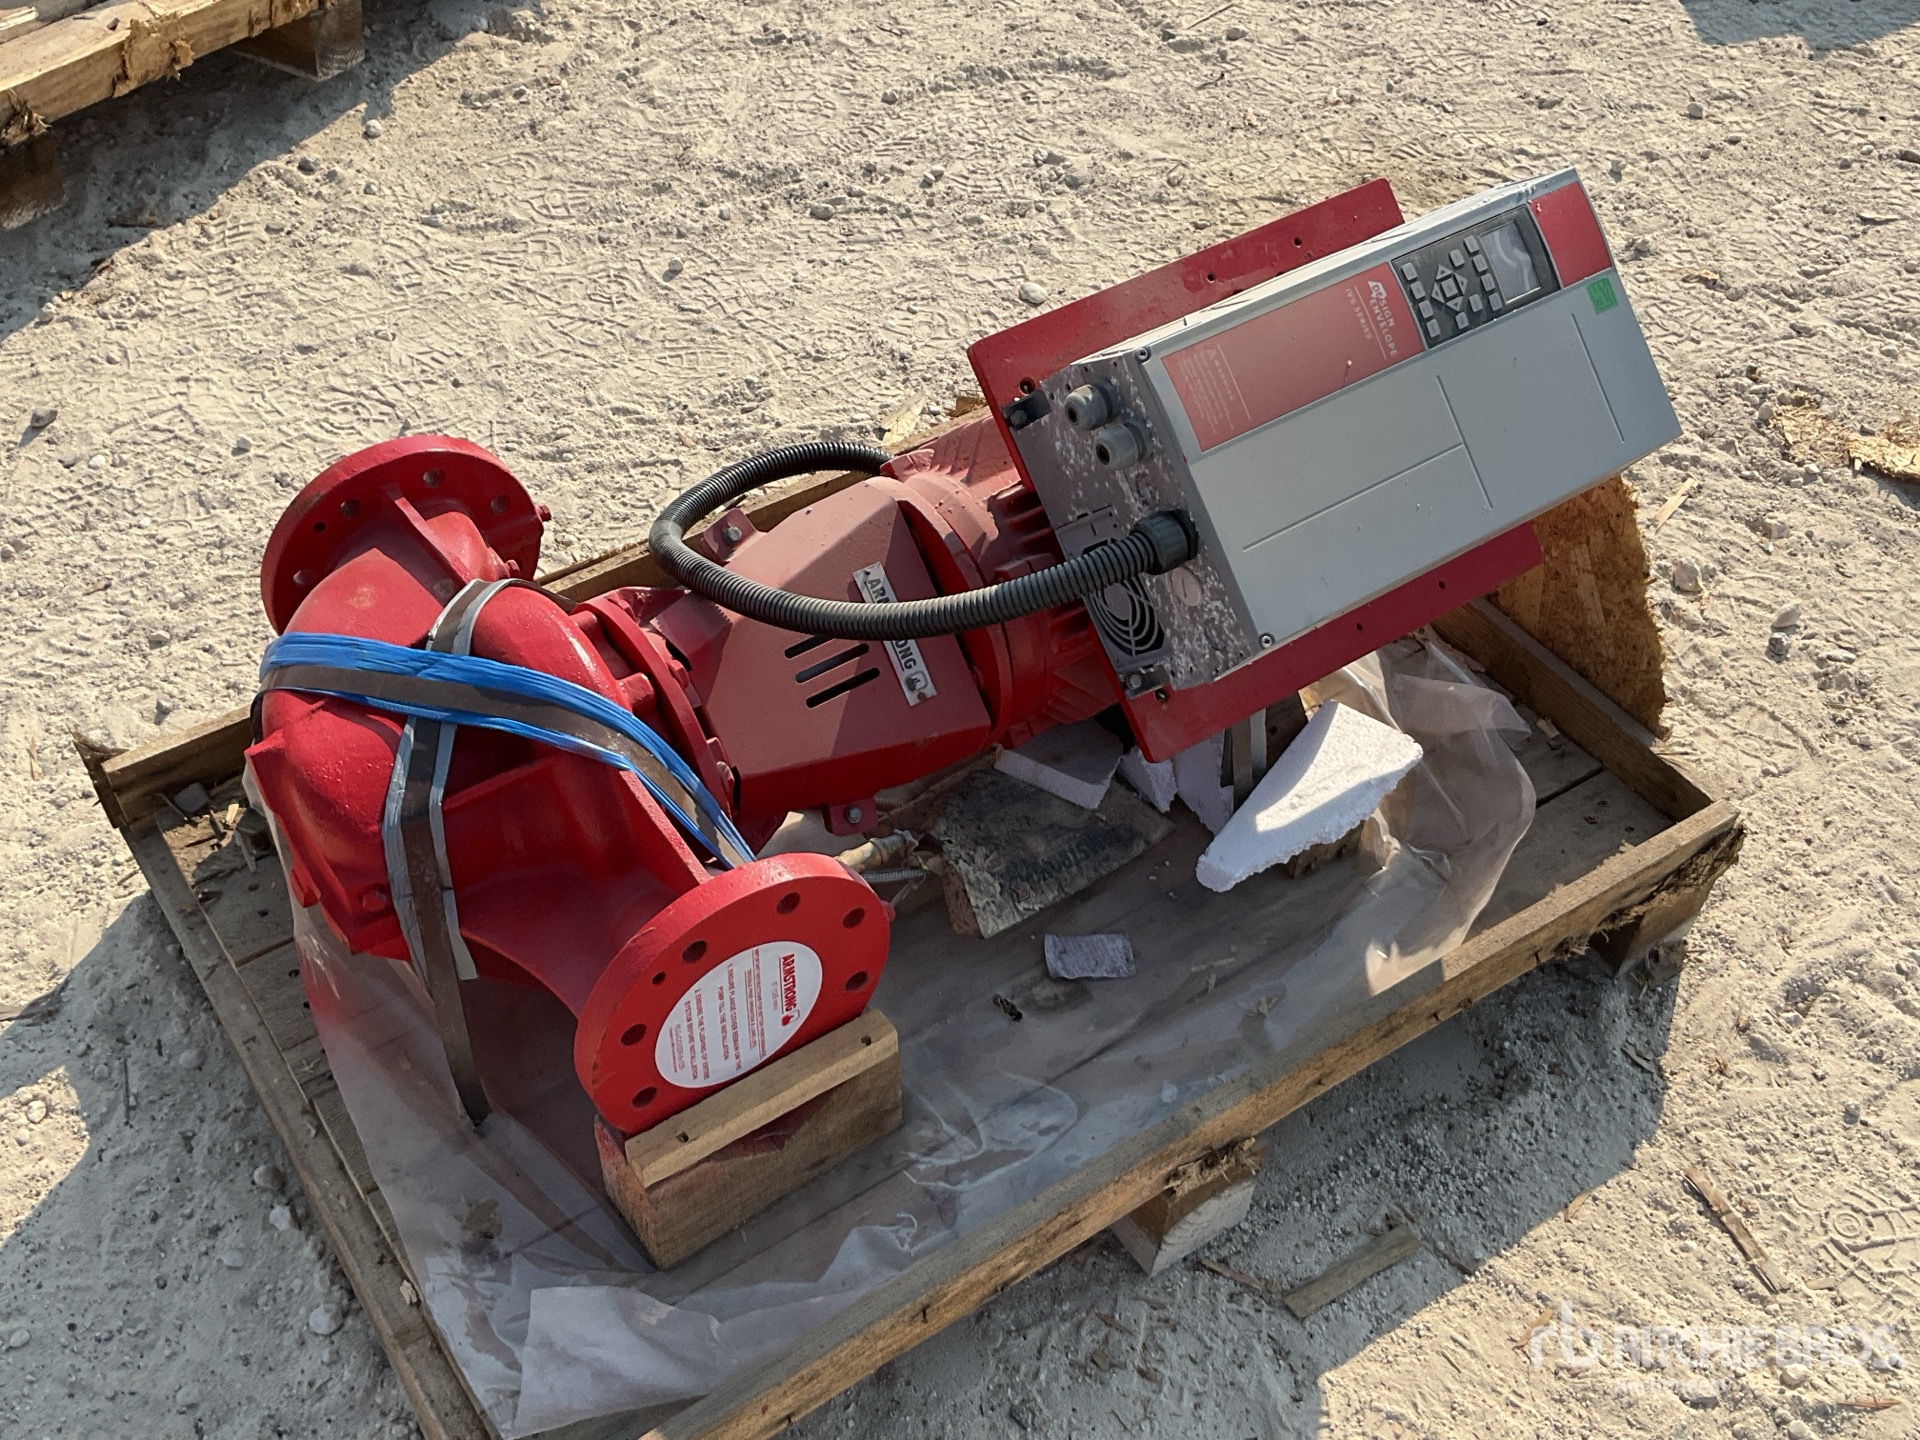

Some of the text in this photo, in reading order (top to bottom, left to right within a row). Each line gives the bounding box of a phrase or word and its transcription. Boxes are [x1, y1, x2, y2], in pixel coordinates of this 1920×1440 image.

[1345, 288, 1373, 339] IVS SERIES
[1369, 298, 1398, 356] ENVELOPE
[1371, 283, 1396, 327] DESIGN
[867, 577, 917, 670] ARONG
[781, 953, 797, 1012] ARMSTRONG
[689, 1044, 697, 1080] INSTALLATION
[698, 1027, 706, 1053] FLUSHING
[721, 1024, 729, 1060] INSTALLATION
